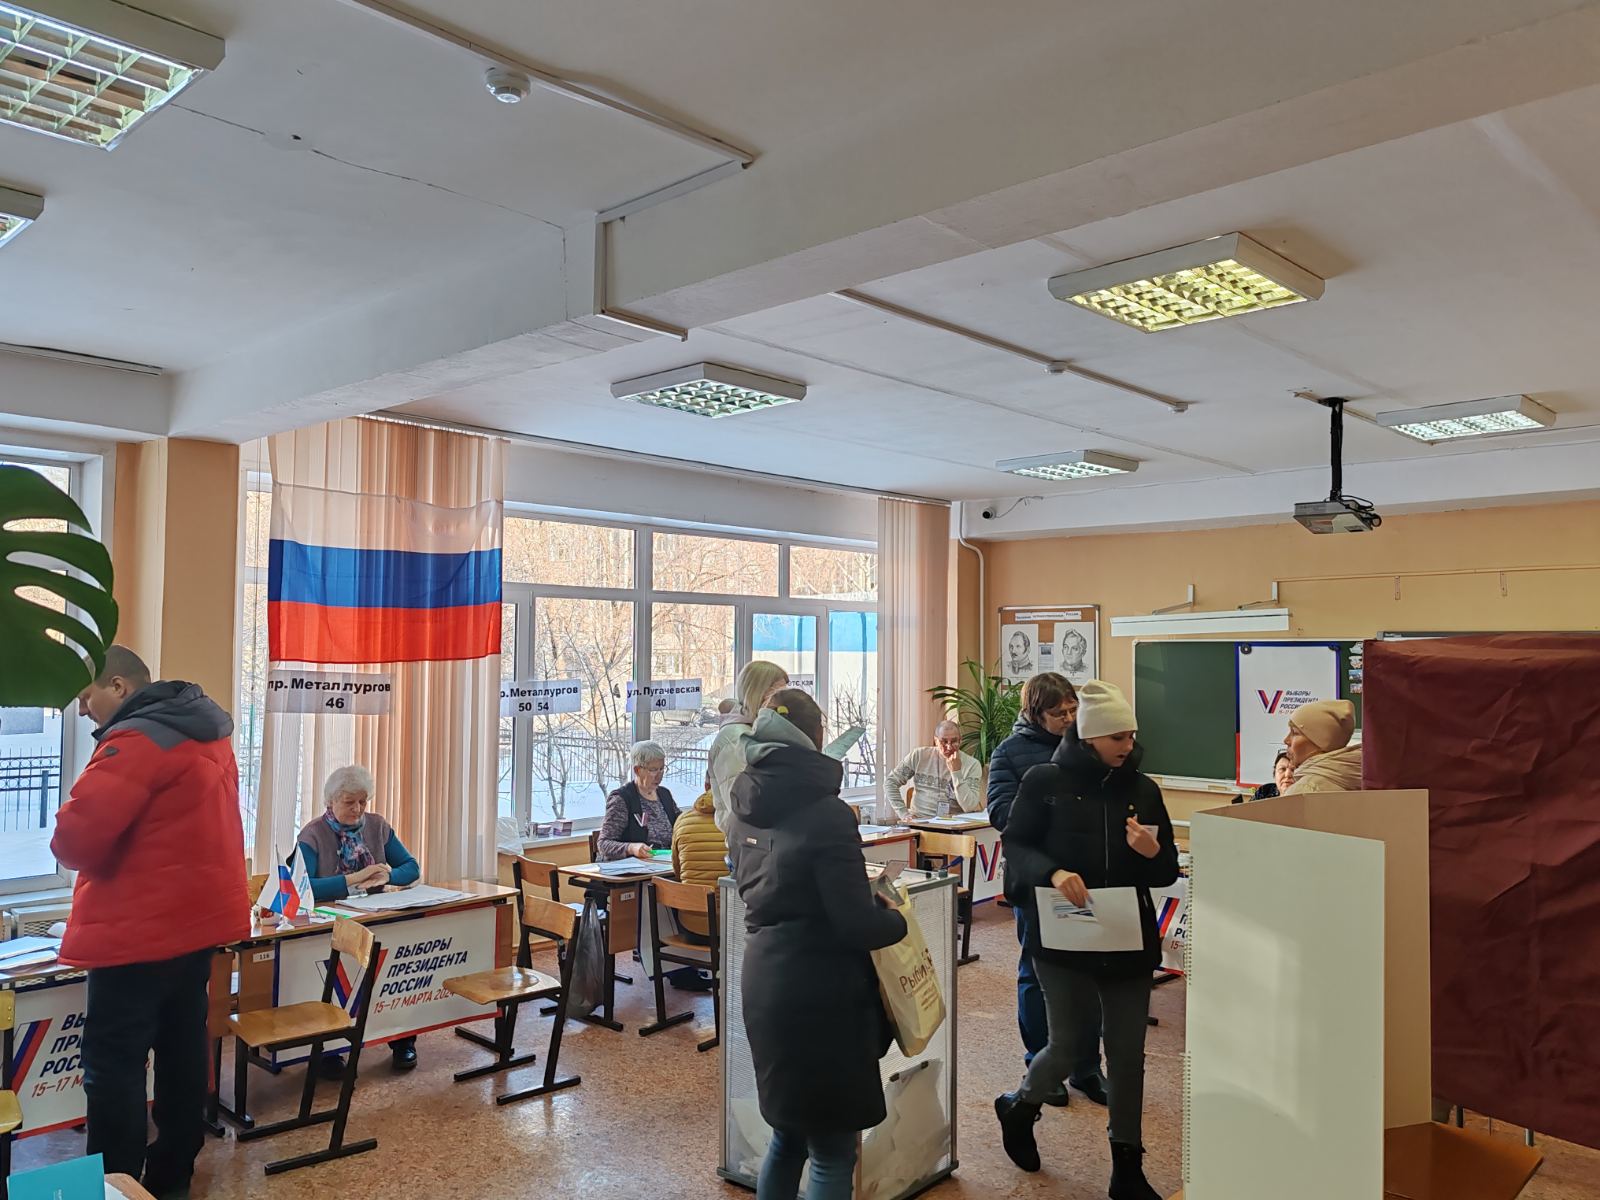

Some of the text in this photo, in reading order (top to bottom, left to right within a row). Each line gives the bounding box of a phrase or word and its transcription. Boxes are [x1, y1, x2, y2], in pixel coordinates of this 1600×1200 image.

[325, 697, 345, 709] 46
[518, 701, 550, 712] 50 54
[655, 698, 667, 707] 40
[394, 937, 453, 960] ВЫБОРЫ
[387, 951, 468, 978] ПРЕЗИДЕНТА
[379, 974, 433, 998] РОССИИ
[401, 991, 433, 1008] МАРТА
